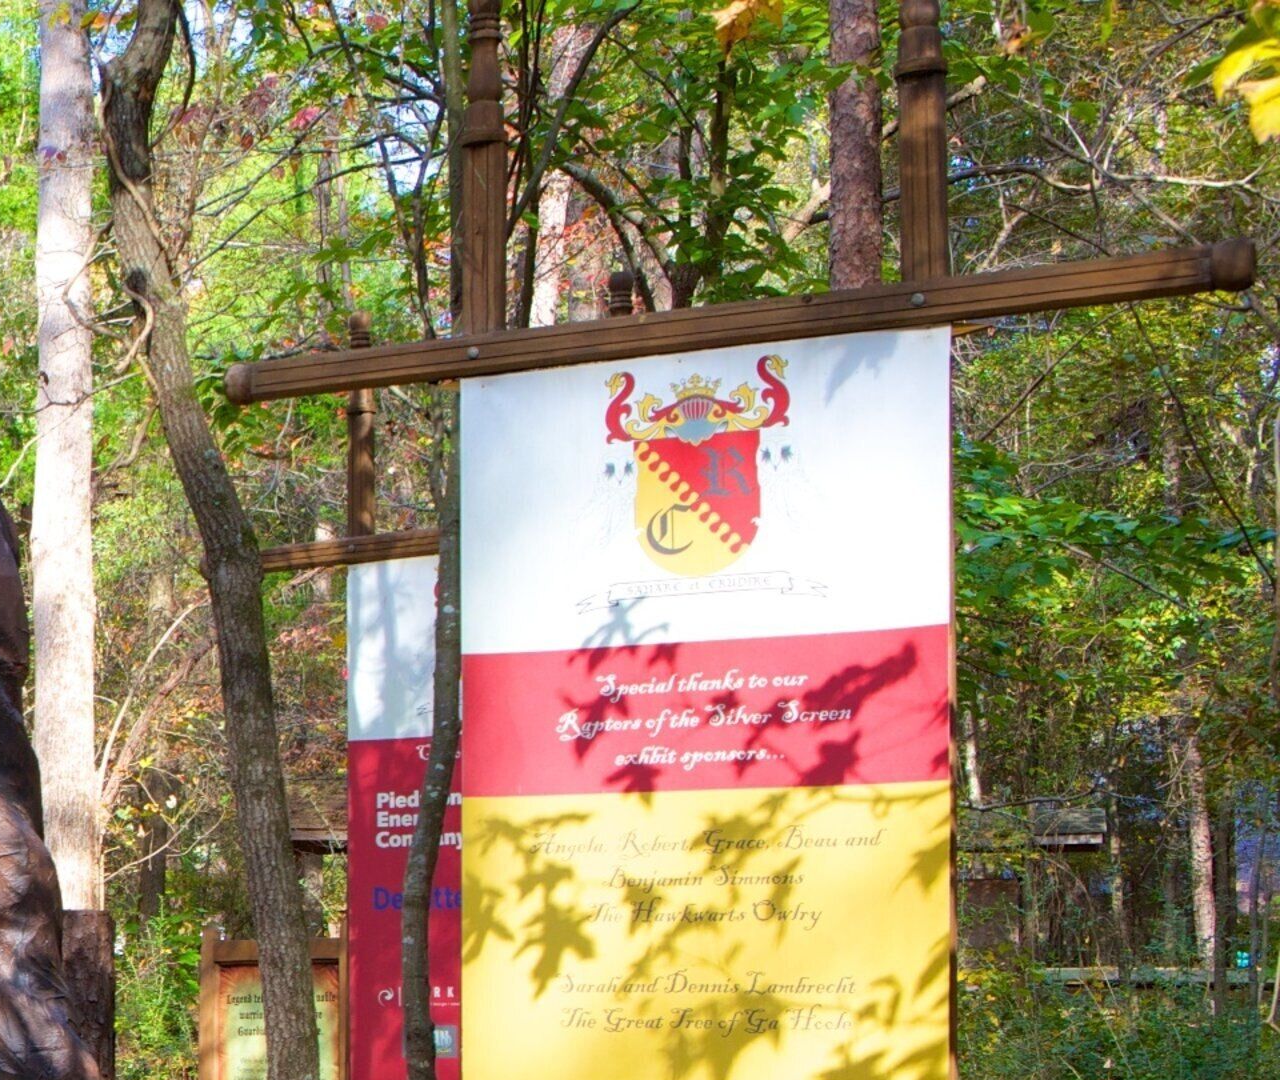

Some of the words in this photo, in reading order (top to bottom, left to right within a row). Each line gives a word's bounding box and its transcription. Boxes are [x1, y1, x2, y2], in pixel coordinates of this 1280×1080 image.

[646, 503, 694, 555] C
[596, 674, 675, 702] Special
[678, 670, 743, 693] thanks
[748, 675, 769, 689] to
[772, 673, 808, 688] our
[555, 709, 640, 742] Raptors
[645, 709, 670, 737] of
[669, 709, 700, 728] the
[704, 703, 772, 727] Silver
[777, 700, 852, 723] Screen
[845, 827, 888, 847] and
[602, 865, 703, 893] Benjamin
[710, 864, 805, 886] Simmons
[631, 897, 746, 923] Hawkwarts
[752, 899, 823, 931] Owlry
[560, 973, 621, 994] Sarah
[622, 975, 664, 994] and
[664, 969, 740, 994] Dennis
[745, 970, 856, 995] Lambrecht
[560, 1007, 597, 1029] The
[603, 1008, 663, 1032] Great
[670, 1007, 713, 1030] Tree
[718, 1011, 740, 1038] of
